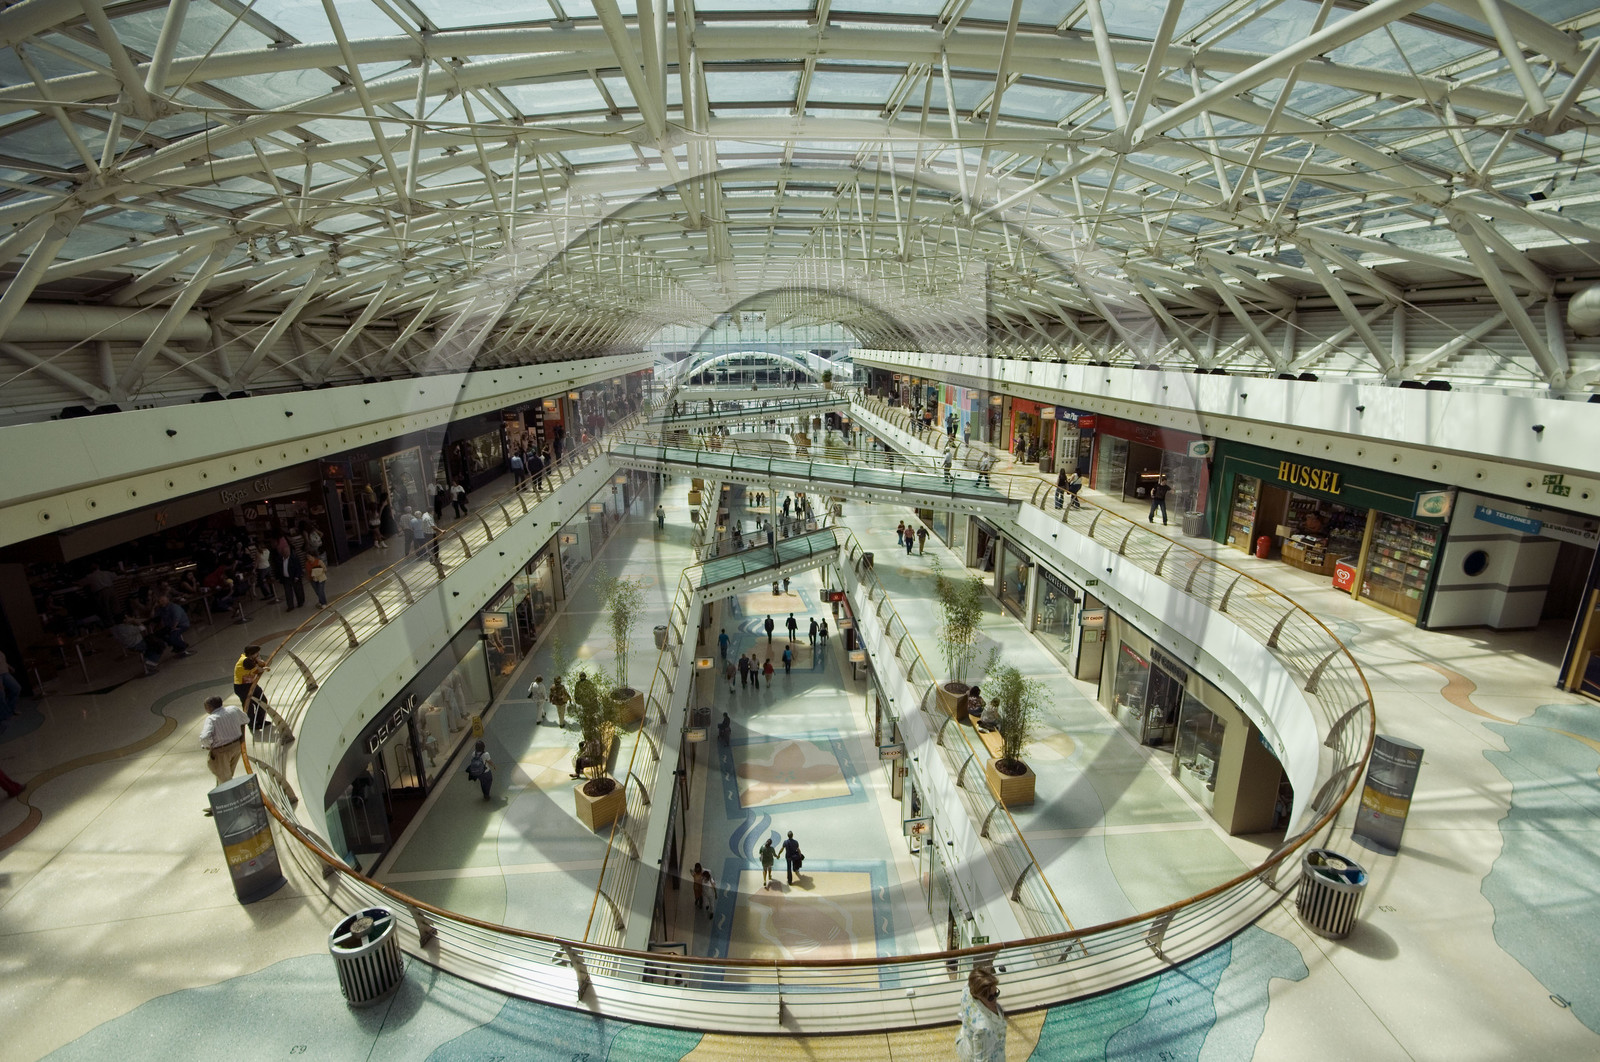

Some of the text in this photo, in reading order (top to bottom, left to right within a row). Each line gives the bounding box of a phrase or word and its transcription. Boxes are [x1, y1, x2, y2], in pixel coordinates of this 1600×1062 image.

[1277, 460, 1341, 495] HUSSEL
[220, 478, 274, 505] Bagas Café
[1495, 511, 1532, 525] TELEFONES
[1542, 522, 1583, 537] ELEVADORES
[1044, 570, 1071, 596] CORTEFIEL
[215, 799, 239, 810] Internet
[231, 852, 253, 864] Wi-Fi
[1159, 1050, 1175, 1062] 1.5
